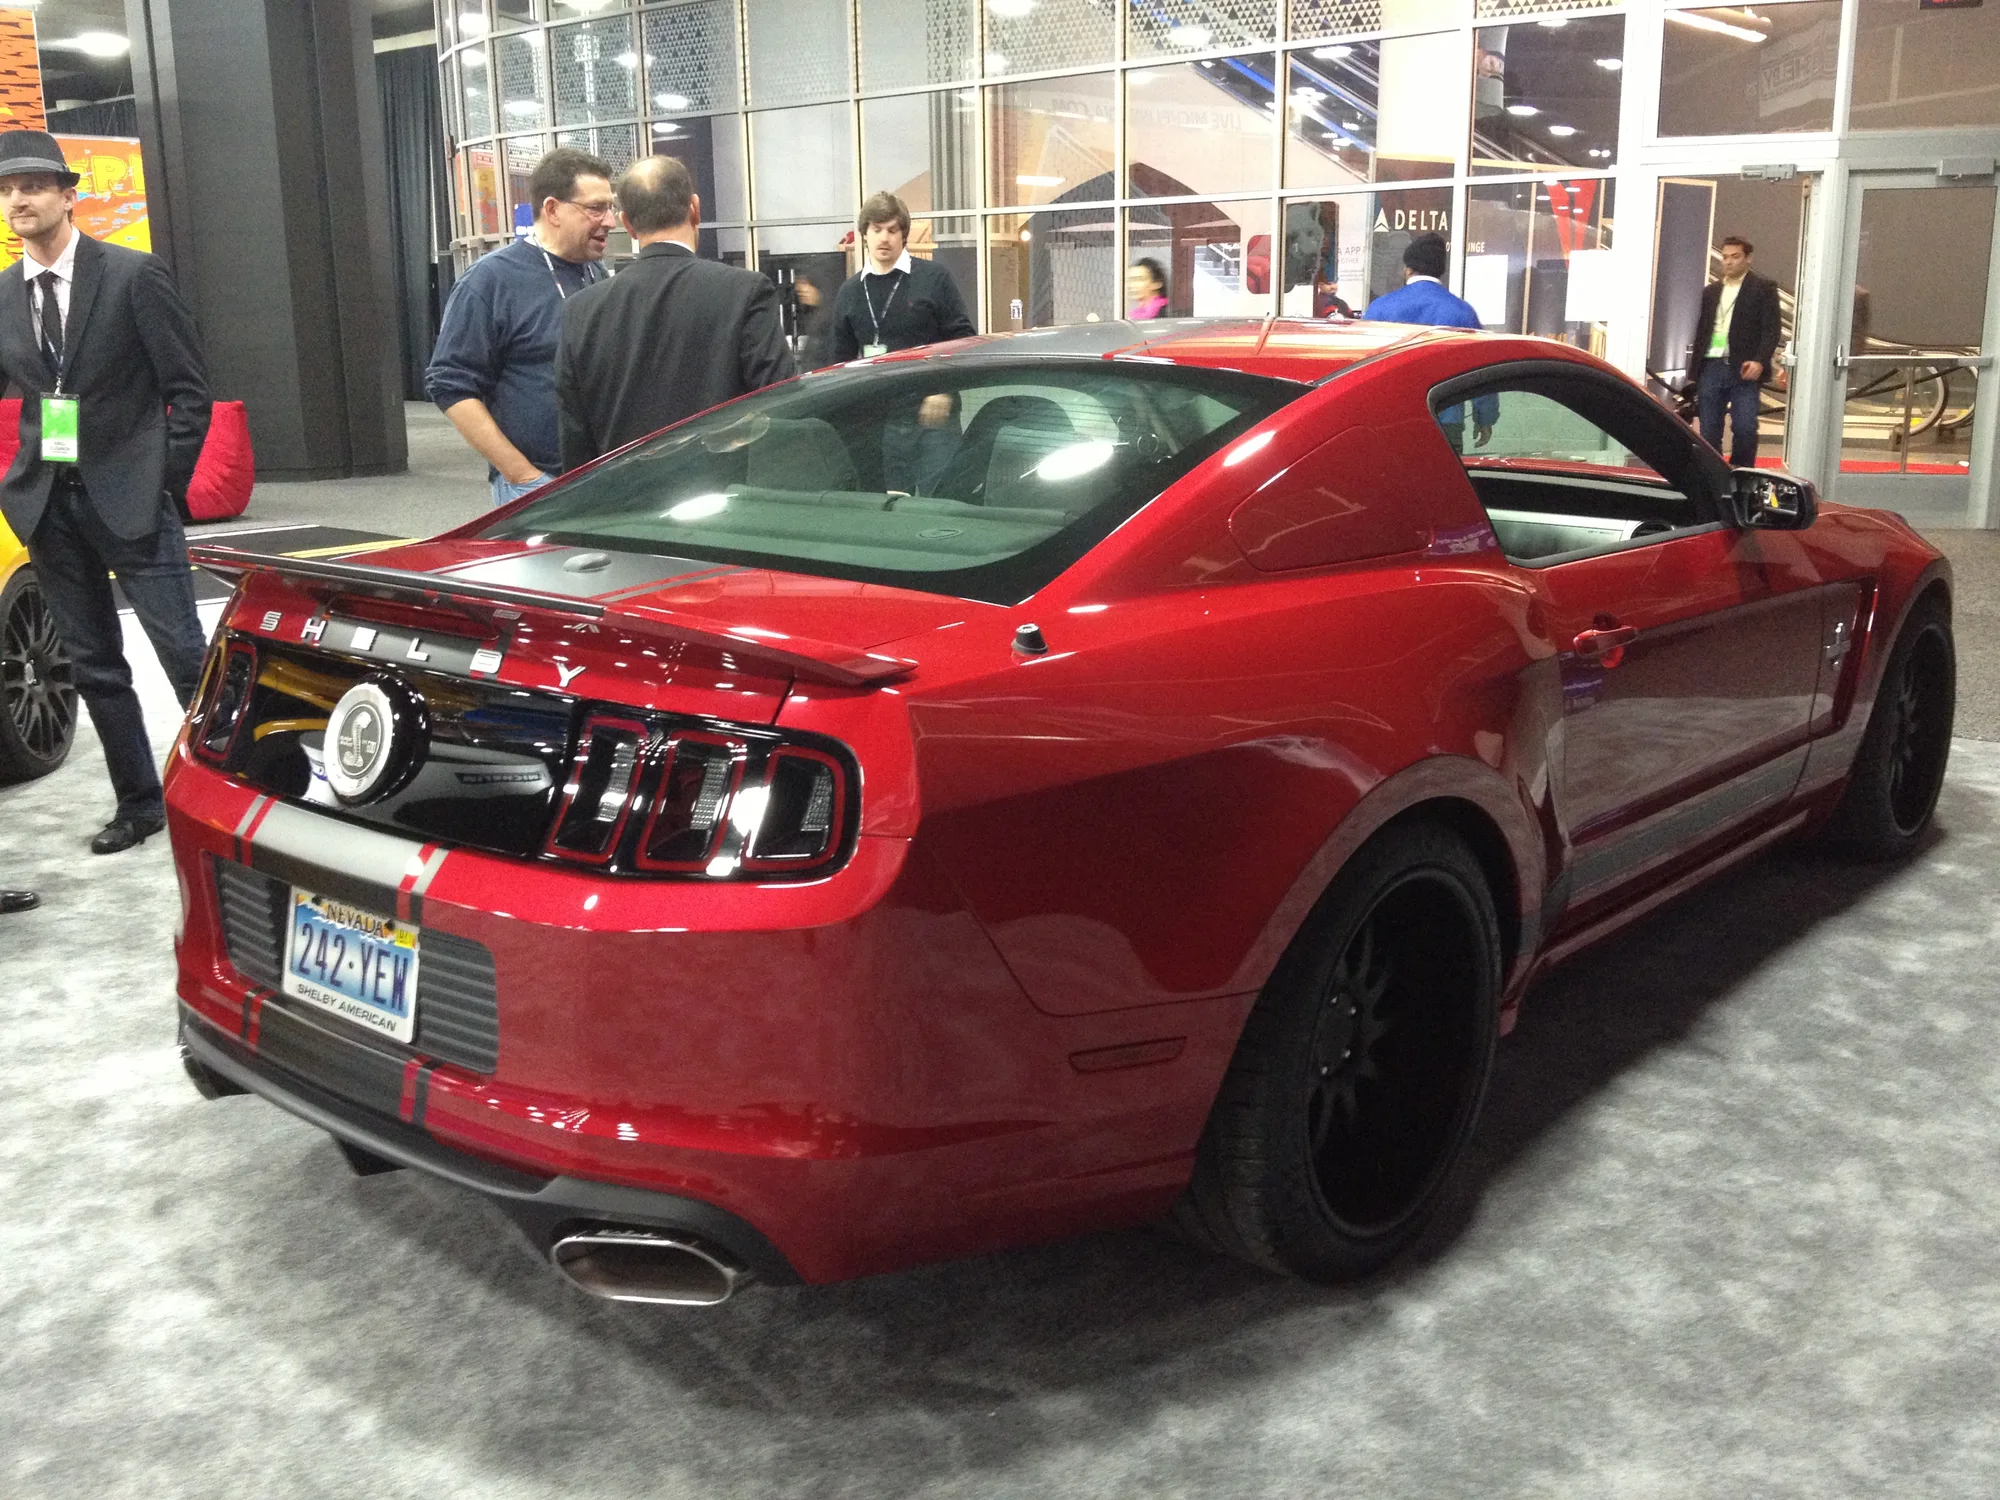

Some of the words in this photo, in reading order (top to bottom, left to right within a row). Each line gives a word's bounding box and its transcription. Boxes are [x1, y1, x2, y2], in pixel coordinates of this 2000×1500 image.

[1394, 209, 1448, 231] DELTA
[260, 611, 586, 687] SHLBY
[327, 904, 385, 938] NEVADA
[297, 983, 337, 1007] SHELBY
[339, 1001, 398, 1032] AMERICAN
